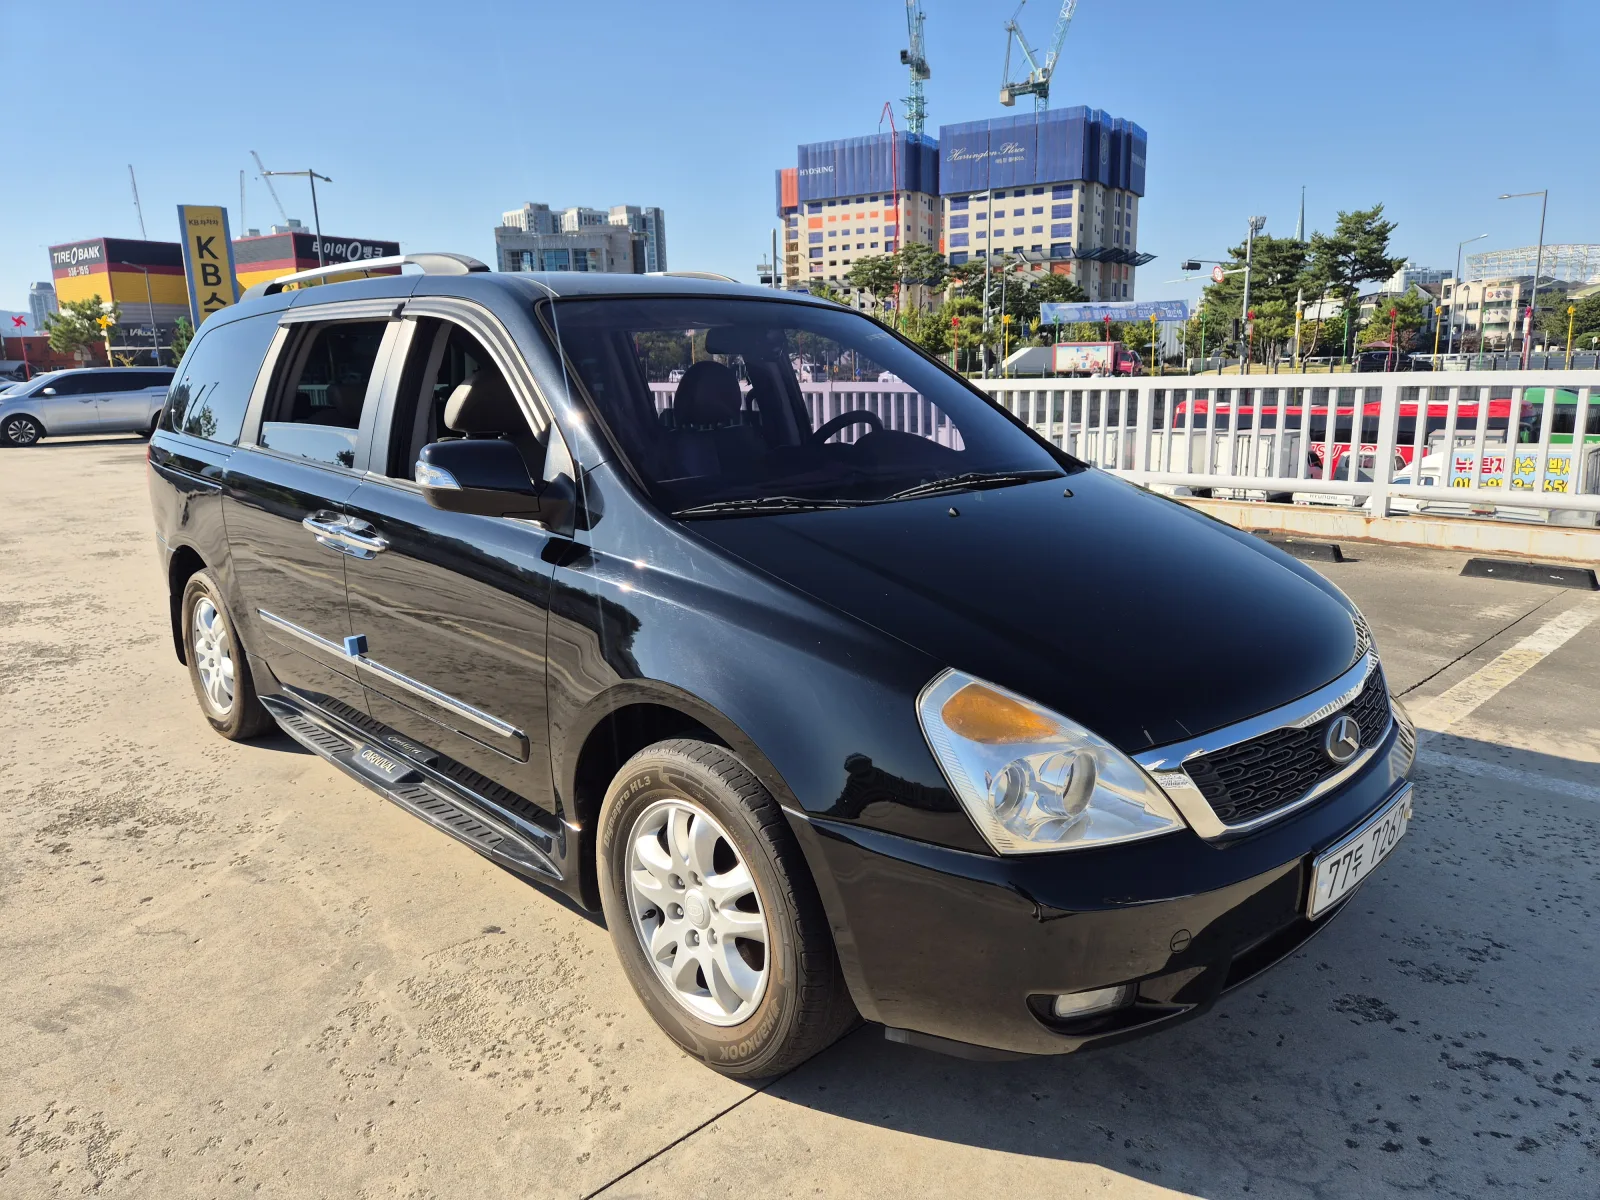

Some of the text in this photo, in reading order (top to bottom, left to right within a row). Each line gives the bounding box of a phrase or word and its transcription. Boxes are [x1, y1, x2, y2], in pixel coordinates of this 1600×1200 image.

[800, 165, 834, 176] HYOSUNG
[361, 749, 397, 774] CARNIVAL
[629, 775, 651, 794] HL3
[1328, 802, 1406, 899] 77두 7267
